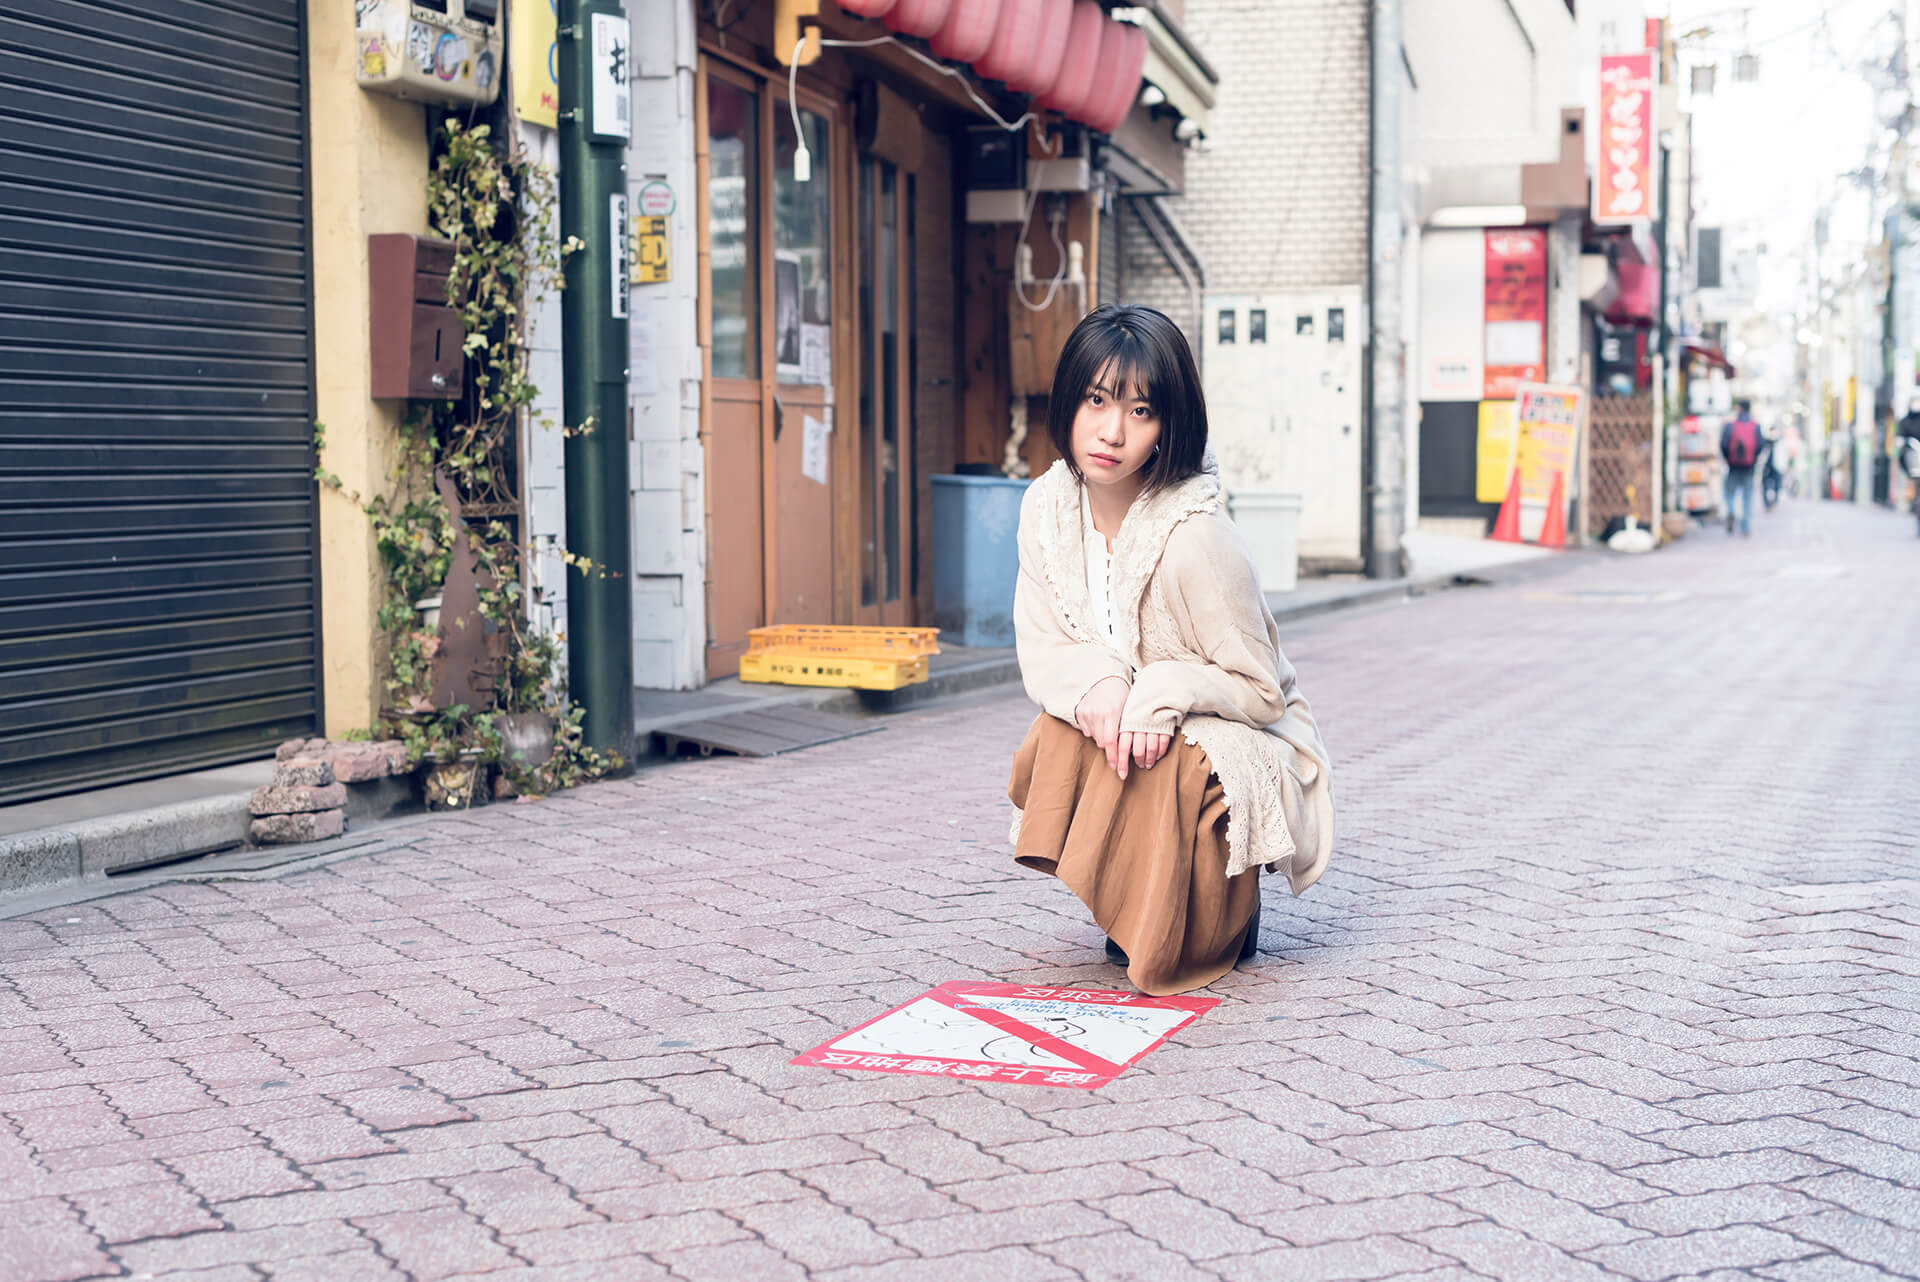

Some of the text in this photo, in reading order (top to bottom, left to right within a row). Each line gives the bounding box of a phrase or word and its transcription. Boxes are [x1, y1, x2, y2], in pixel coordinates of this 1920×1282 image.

[817, 1052, 1099, 1084] 路上禁煙地区
